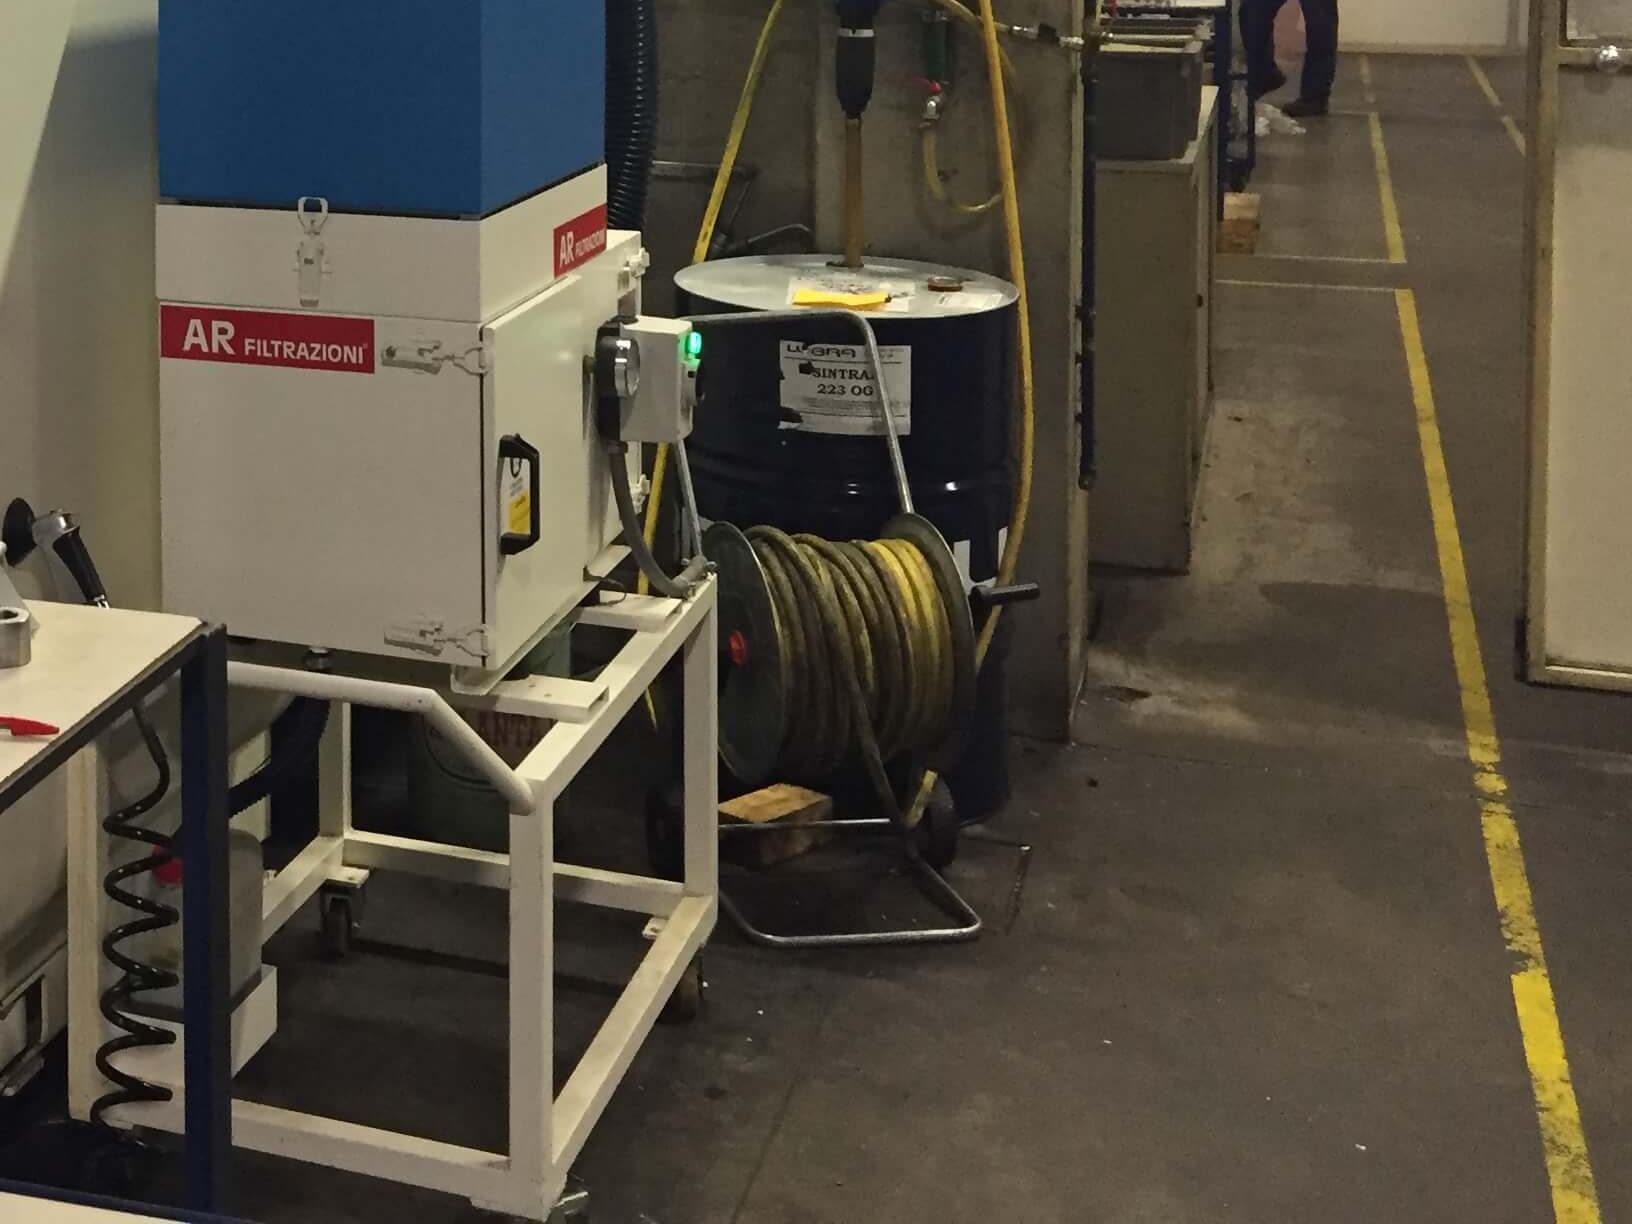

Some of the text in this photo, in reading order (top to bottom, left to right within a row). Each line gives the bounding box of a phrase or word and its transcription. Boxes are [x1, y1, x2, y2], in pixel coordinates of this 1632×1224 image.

[559, 230, 575, 268] AR
[182, 318, 364, 364] AR FILTRAZIONI
[818, 383, 846, 396] 223
